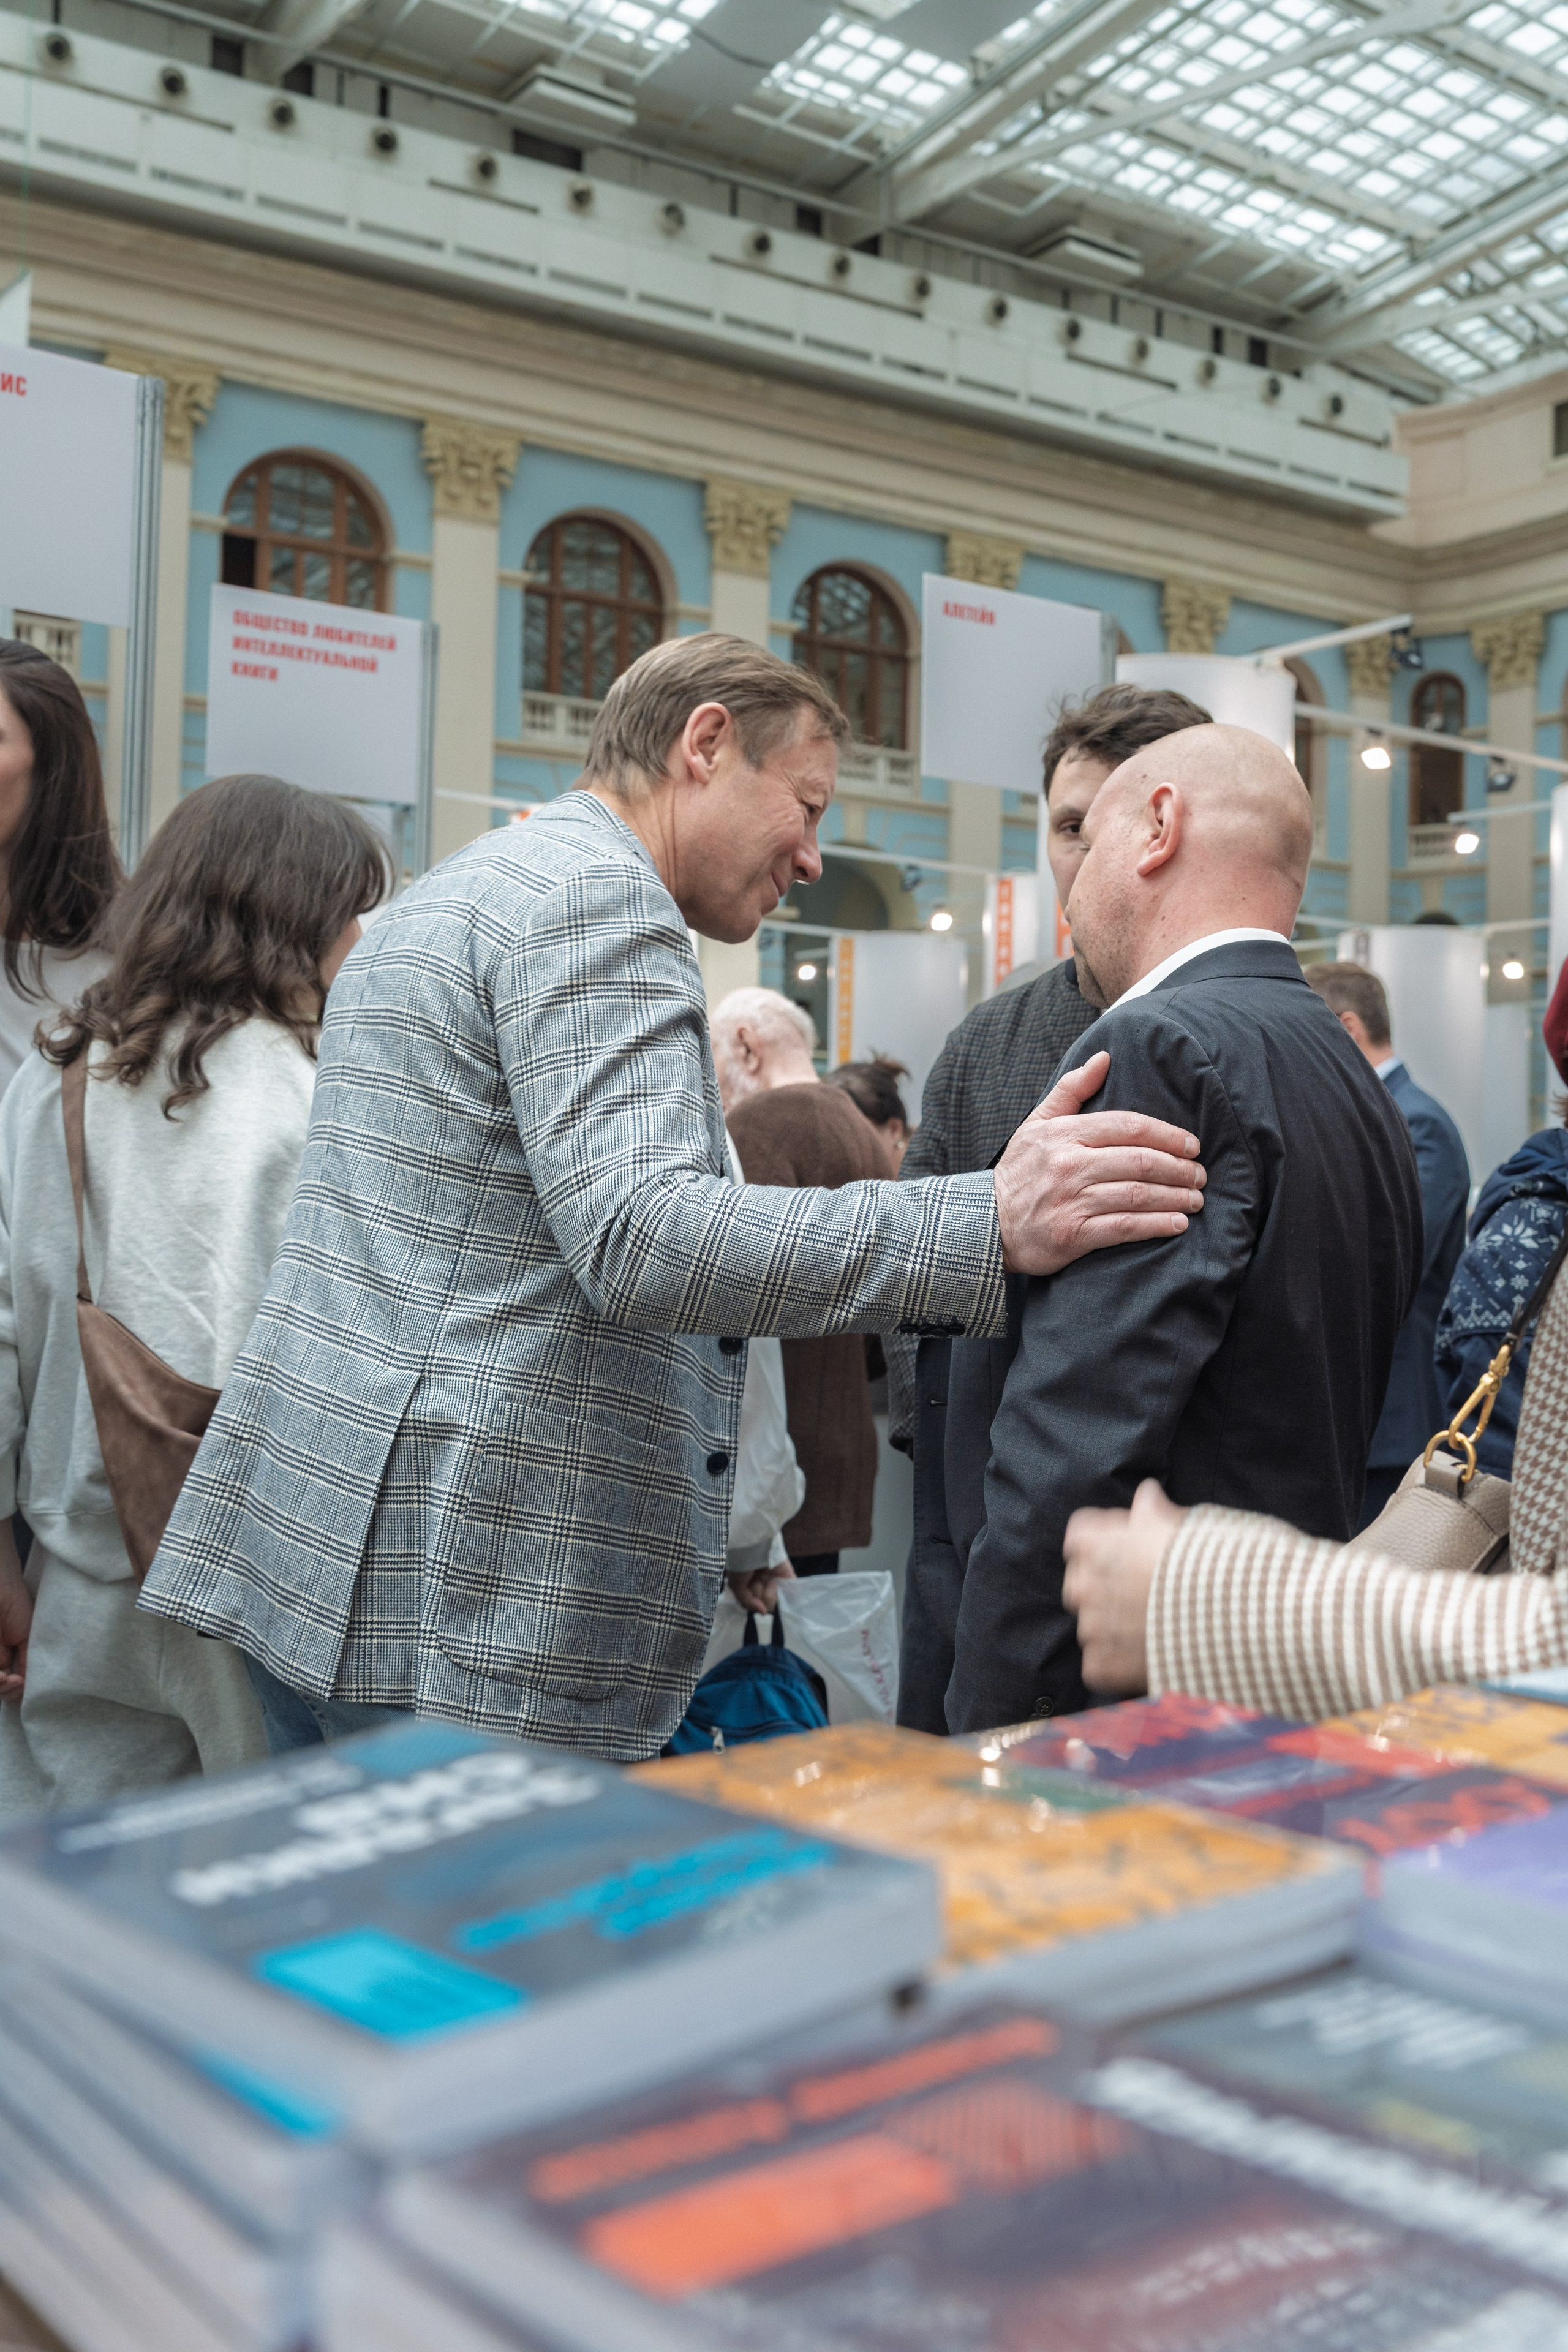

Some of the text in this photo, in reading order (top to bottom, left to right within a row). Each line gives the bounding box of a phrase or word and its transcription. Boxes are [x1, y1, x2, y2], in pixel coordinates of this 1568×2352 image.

[233, 610, 396, 652] ОБЩЕСТВО ЛЮБИТЕЛЕЙ
[232, 662, 278, 681] КНИГИ
[233, 636, 377, 673] ИНТЕЛЛЕКТУАЛЬНОЙ
